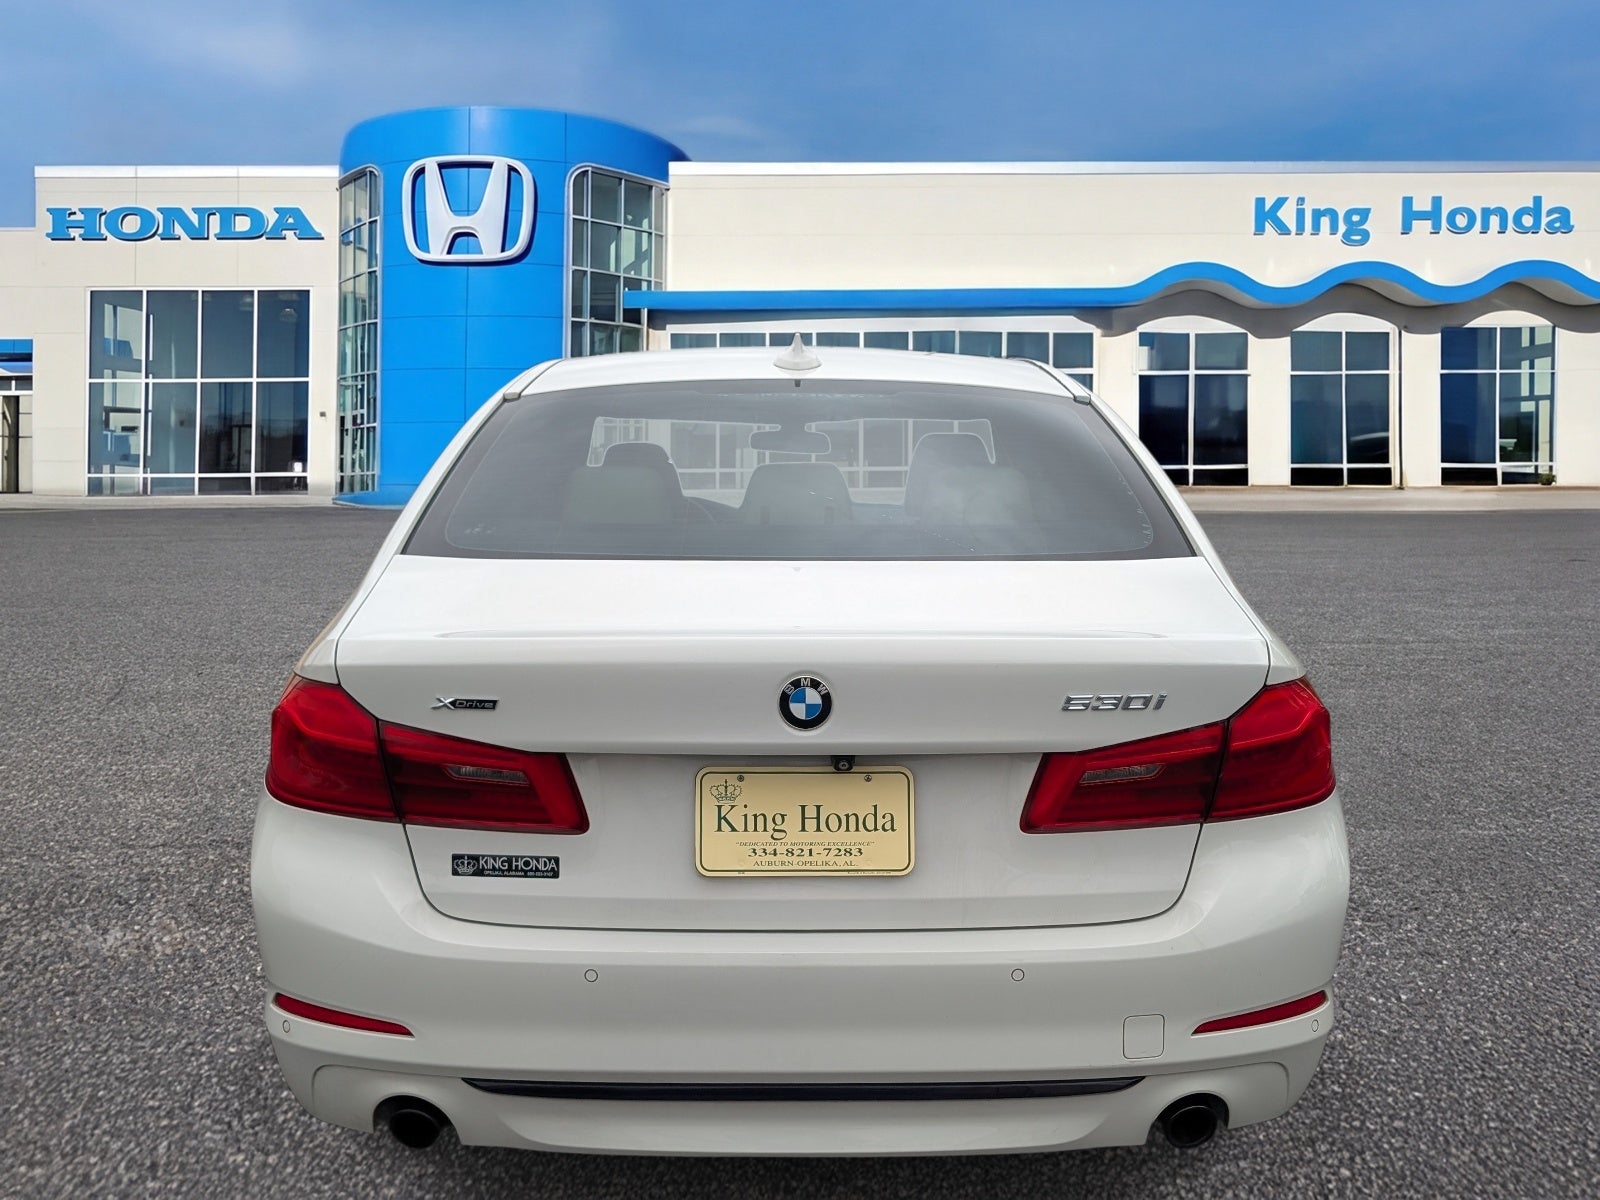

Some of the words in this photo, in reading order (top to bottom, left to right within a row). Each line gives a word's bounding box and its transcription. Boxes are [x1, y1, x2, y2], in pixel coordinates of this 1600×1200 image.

[45, 205, 325, 242] HONDA
[1252, 195, 1372, 247] King
[1400, 195, 1575, 235] Honda
[783, 677, 829, 696] BMW
[1061, 693, 1168, 711] 530i
[713, 803, 788, 841] King
[797, 803, 898, 833] Honda
[747, 847, 864, 858] 334-821-7283
[479, 856, 508, 870] KING
[512, 857, 558, 871] HONDA
